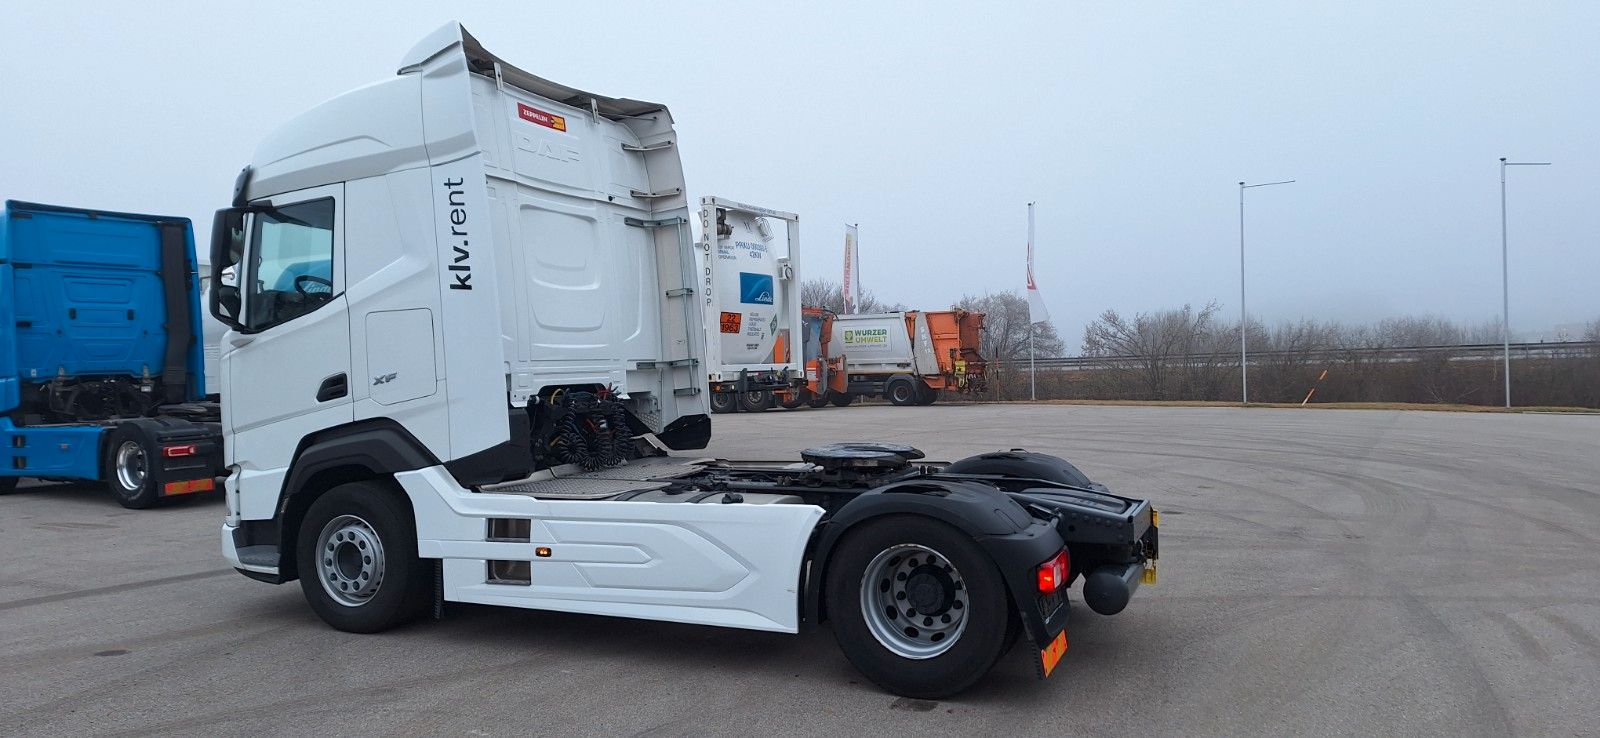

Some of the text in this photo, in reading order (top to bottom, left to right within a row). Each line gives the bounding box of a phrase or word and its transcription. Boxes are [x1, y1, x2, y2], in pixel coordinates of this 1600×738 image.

[523, 108, 548, 122] ZEPPELIN
[516, 134, 581, 163] DAF
[703, 209, 709, 228] DO
[444, 177, 472, 290] klv.rent
[721, 323, 739, 331] 1963
[855, 336, 887, 344] UMWELT
[373, 372, 397, 386] XF
